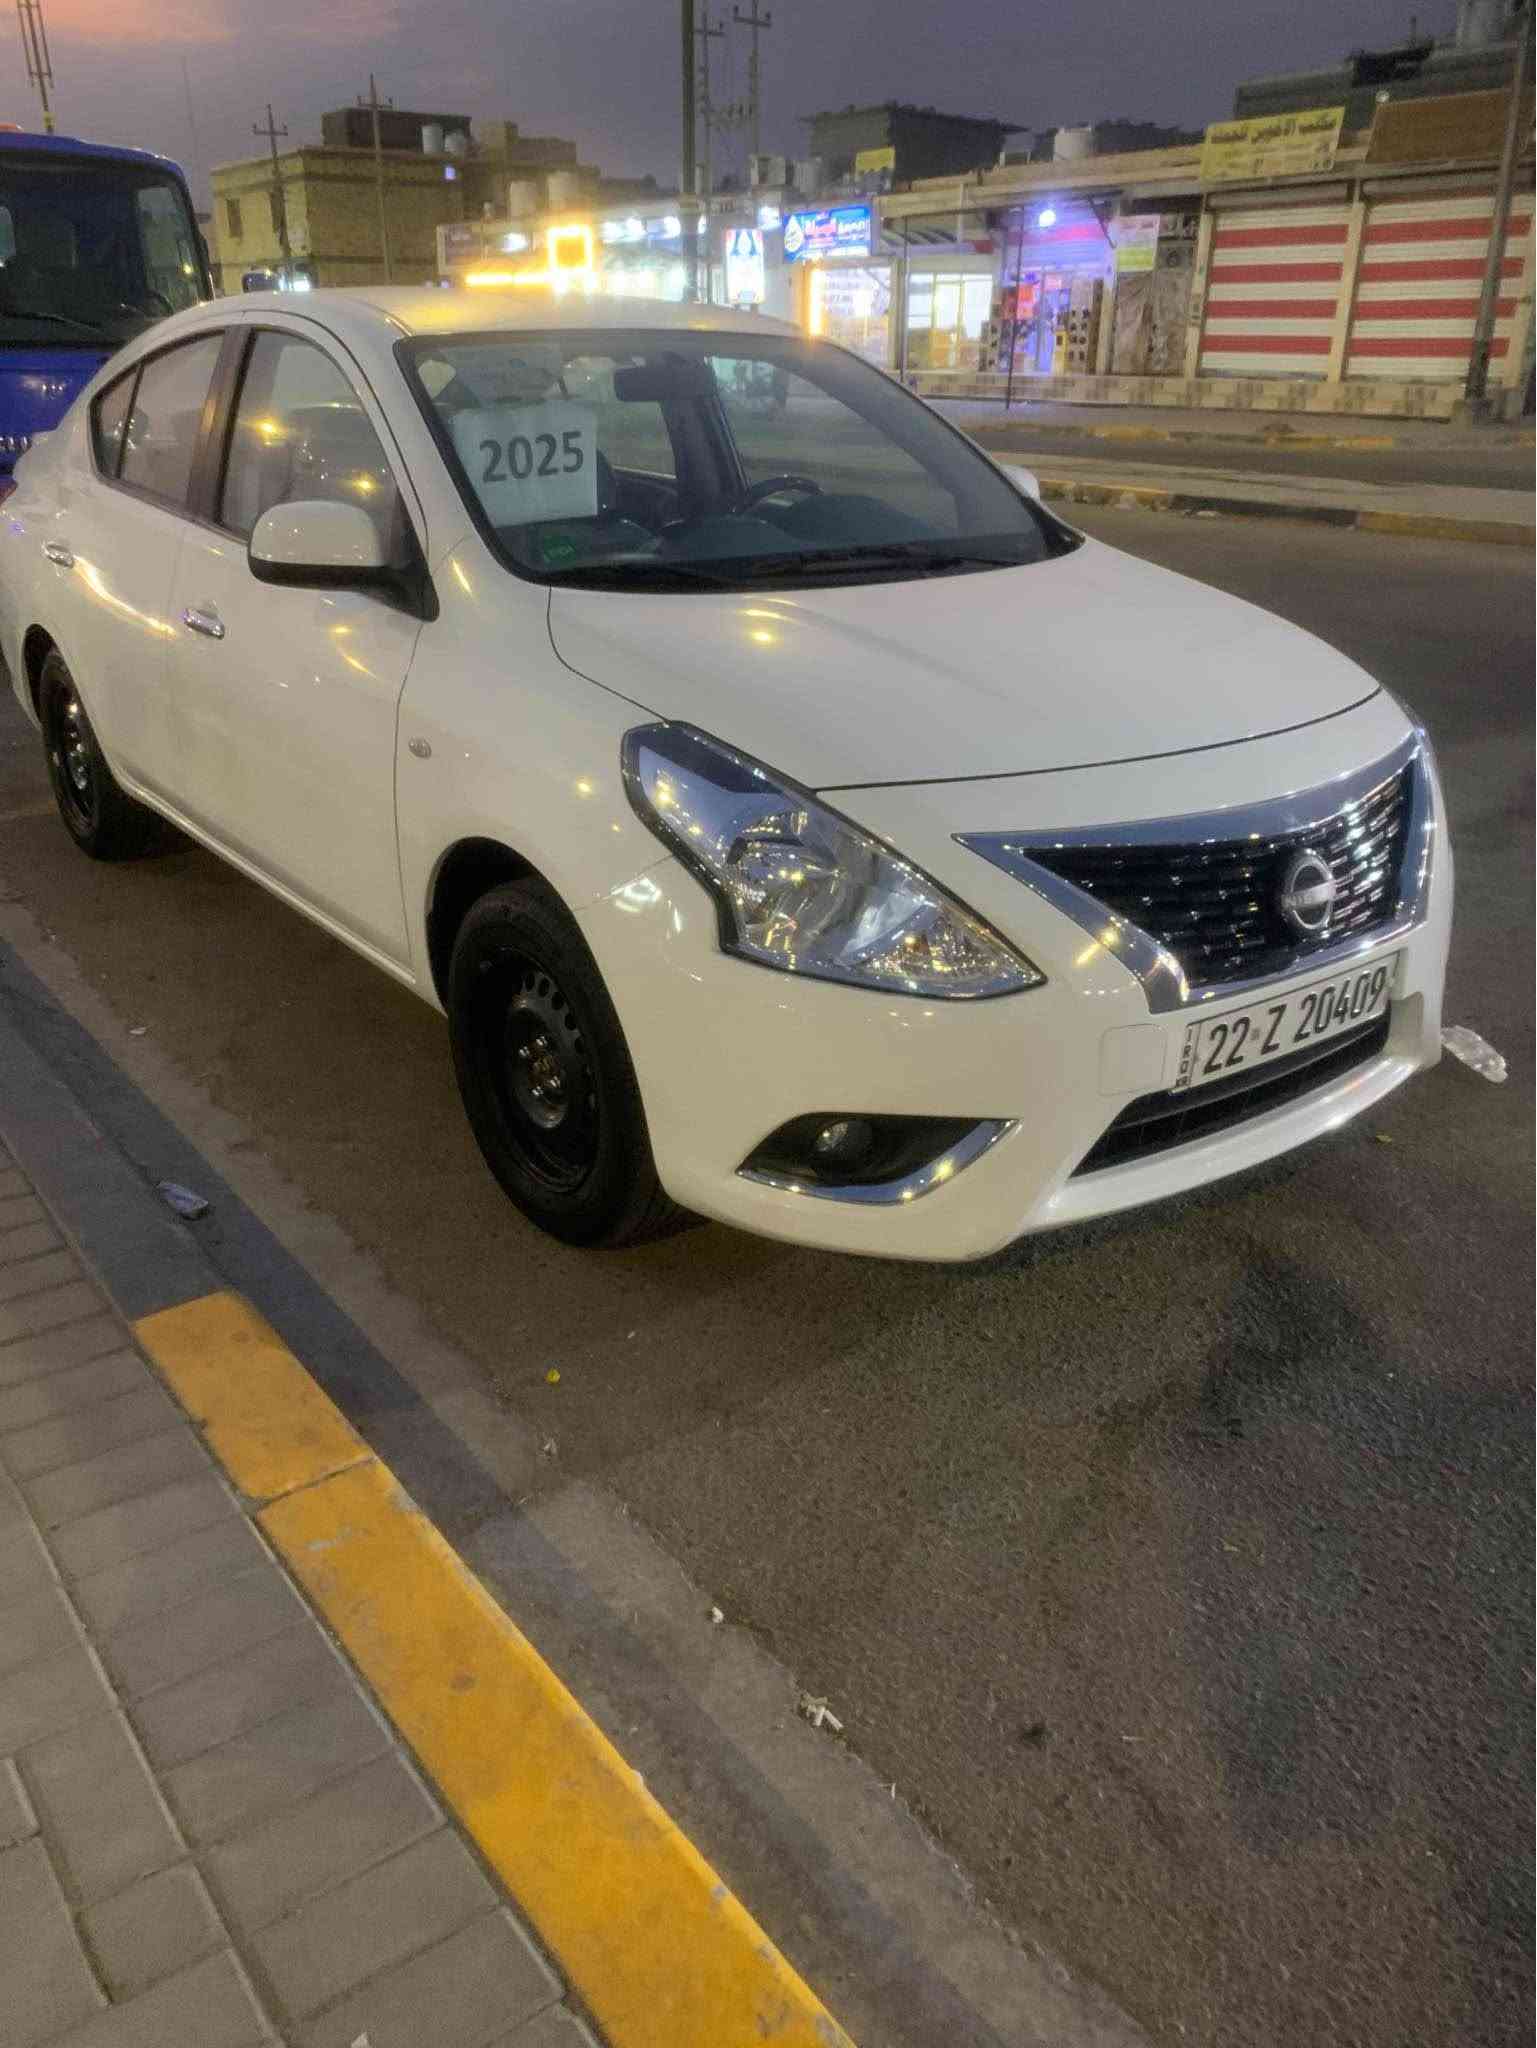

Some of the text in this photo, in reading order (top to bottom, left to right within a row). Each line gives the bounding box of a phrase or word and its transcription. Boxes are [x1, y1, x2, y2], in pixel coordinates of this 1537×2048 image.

[479, 430, 584, 483] 2025
[1202, 965, 1387, 1075] 22 Z 20409
